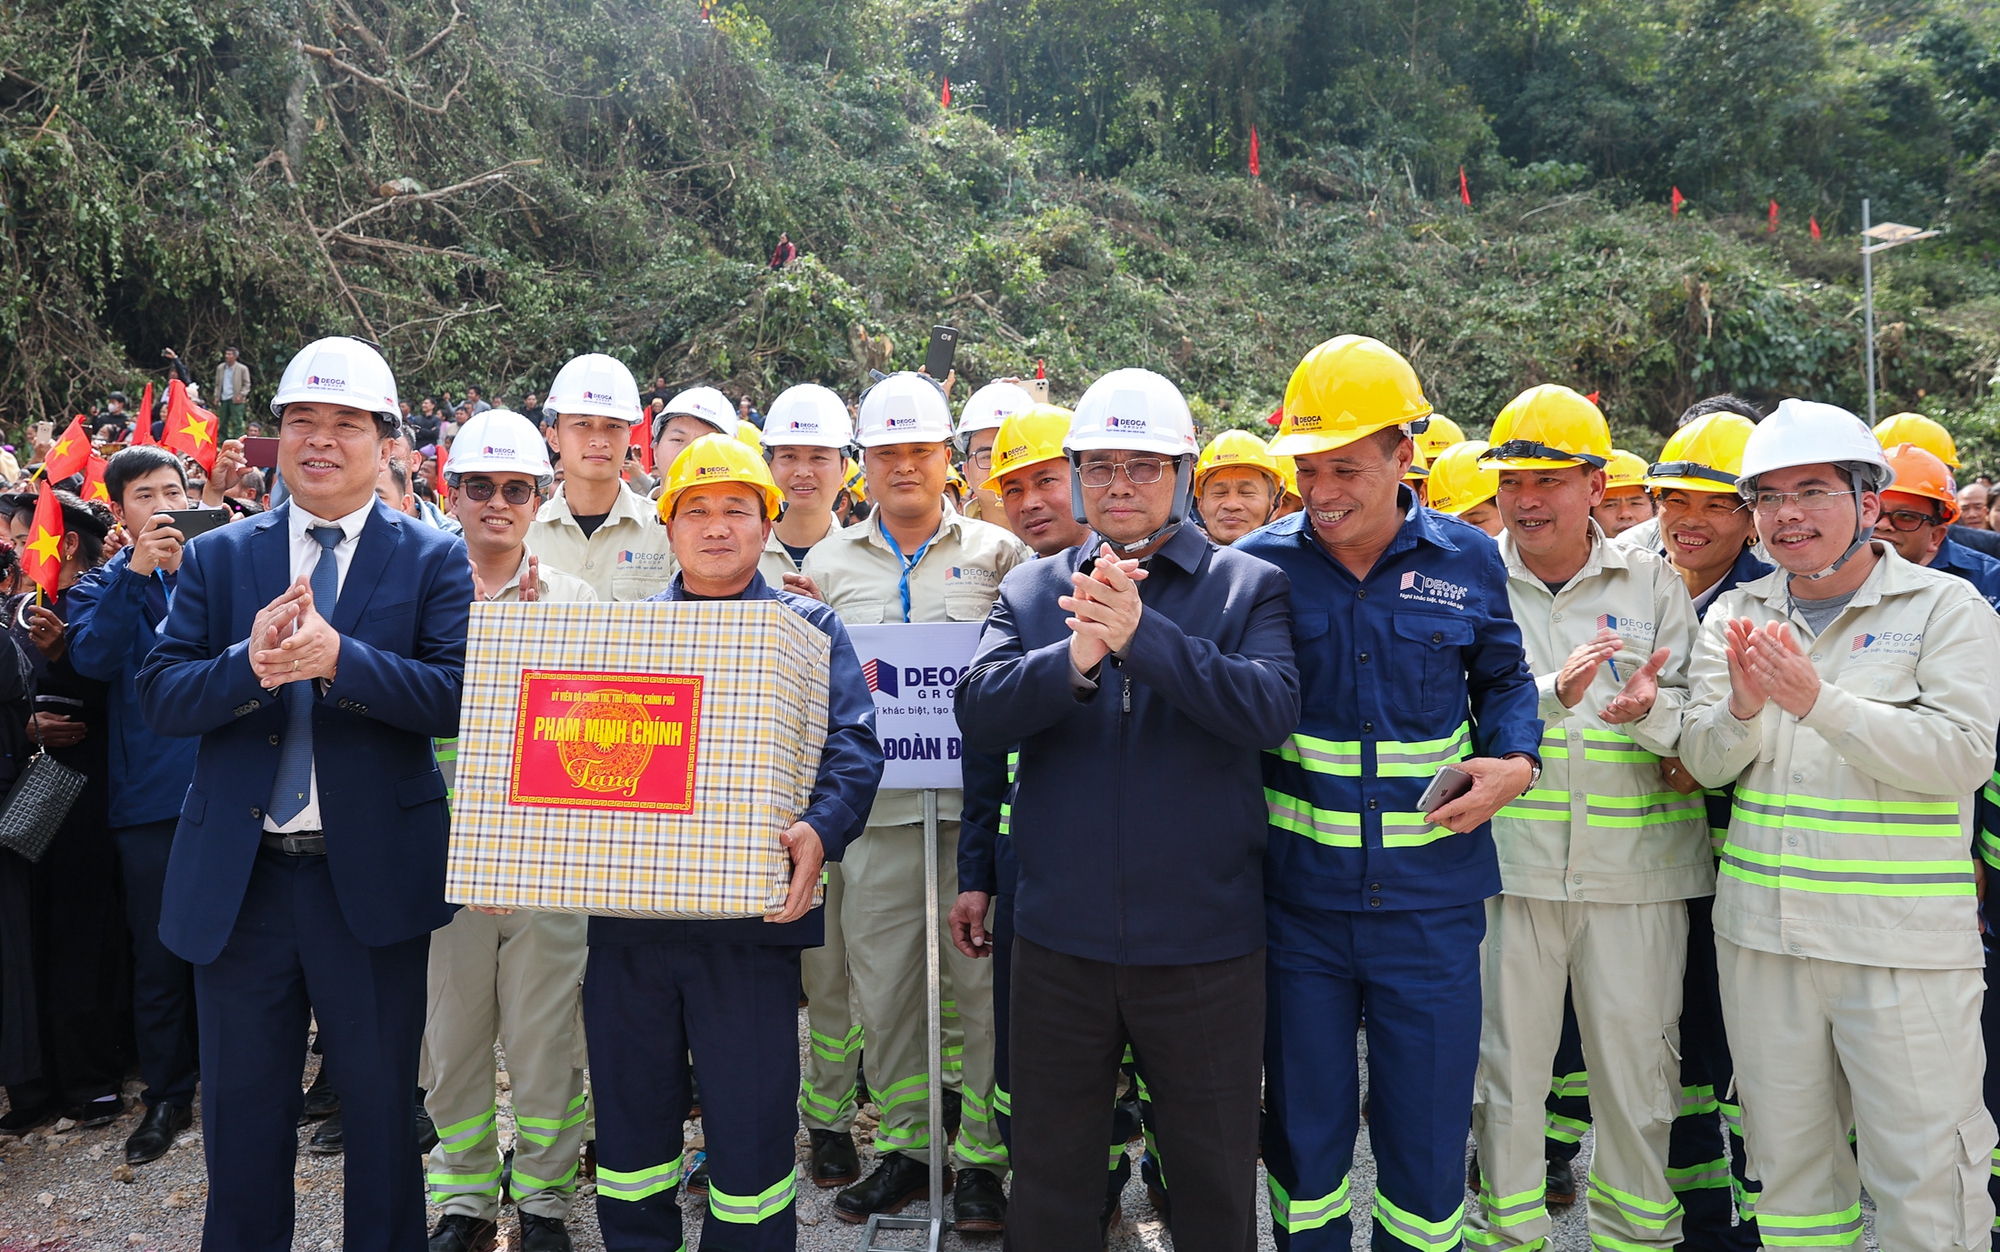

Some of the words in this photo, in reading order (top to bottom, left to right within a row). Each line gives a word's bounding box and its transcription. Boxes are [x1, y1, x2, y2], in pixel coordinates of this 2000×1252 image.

[1425, 578, 1467, 597] DEOCA
[1430, 589, 1461, 600] GROUP
[560, 690, 573, 702] VIÊN
[582, 690, 600, 703] CHÍNH
[644, 693, 662, 705] CHÍNH
[662, 692, 676, 706] PHỦ
[883, 706, 905, 715] khác
[908, 706, 929, 715] biệt,
[933, 707, 948, 715] tạo
[533, 716, 580, 746] PHẠM
[584, 718, 627, 744] MINH
[631, 716, 683, 746] CHÍNH
[884, 733, 941, 760] ĐOÀN
[566, 758, 641, 797] Tặng
